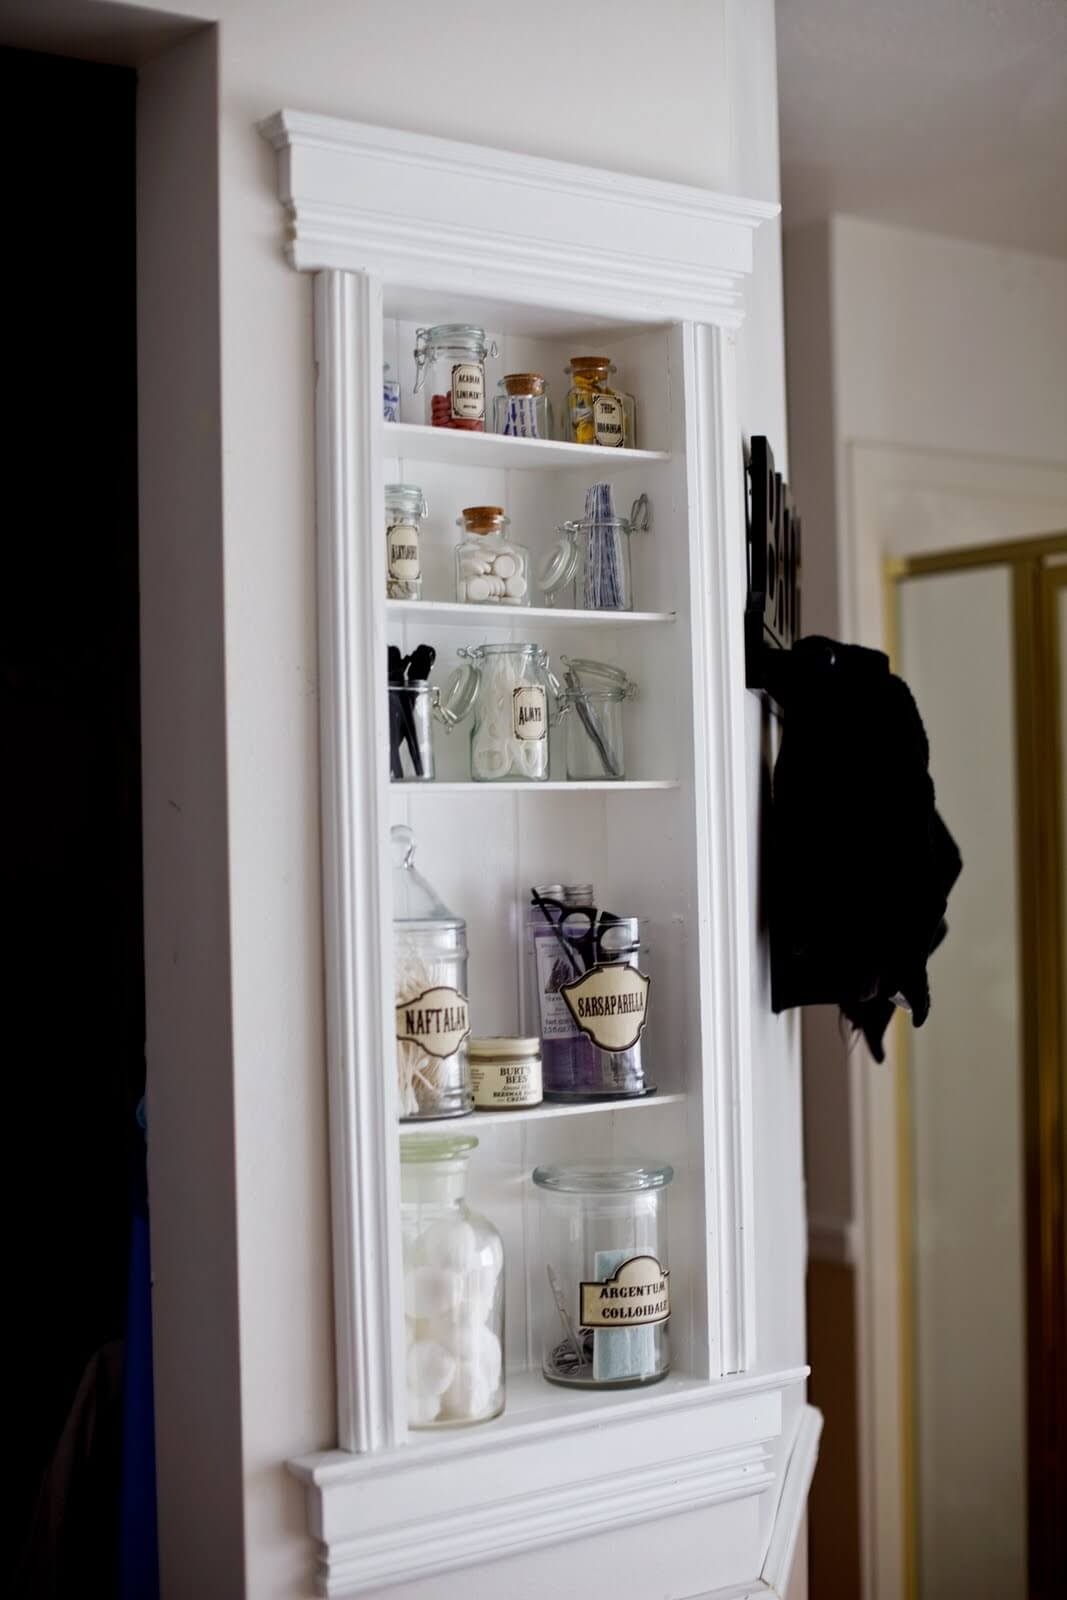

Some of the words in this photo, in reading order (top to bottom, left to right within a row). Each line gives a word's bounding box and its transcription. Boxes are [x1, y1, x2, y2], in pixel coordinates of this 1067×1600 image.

[578, 991, 644, 1018] SARSAPARILLA
[405, 1006, 466, 1035] NAFTALAN
[599, 1280, 665, 1299] ARGENTUM
[601, 1300, 668, 1319] COLLOIDALE
